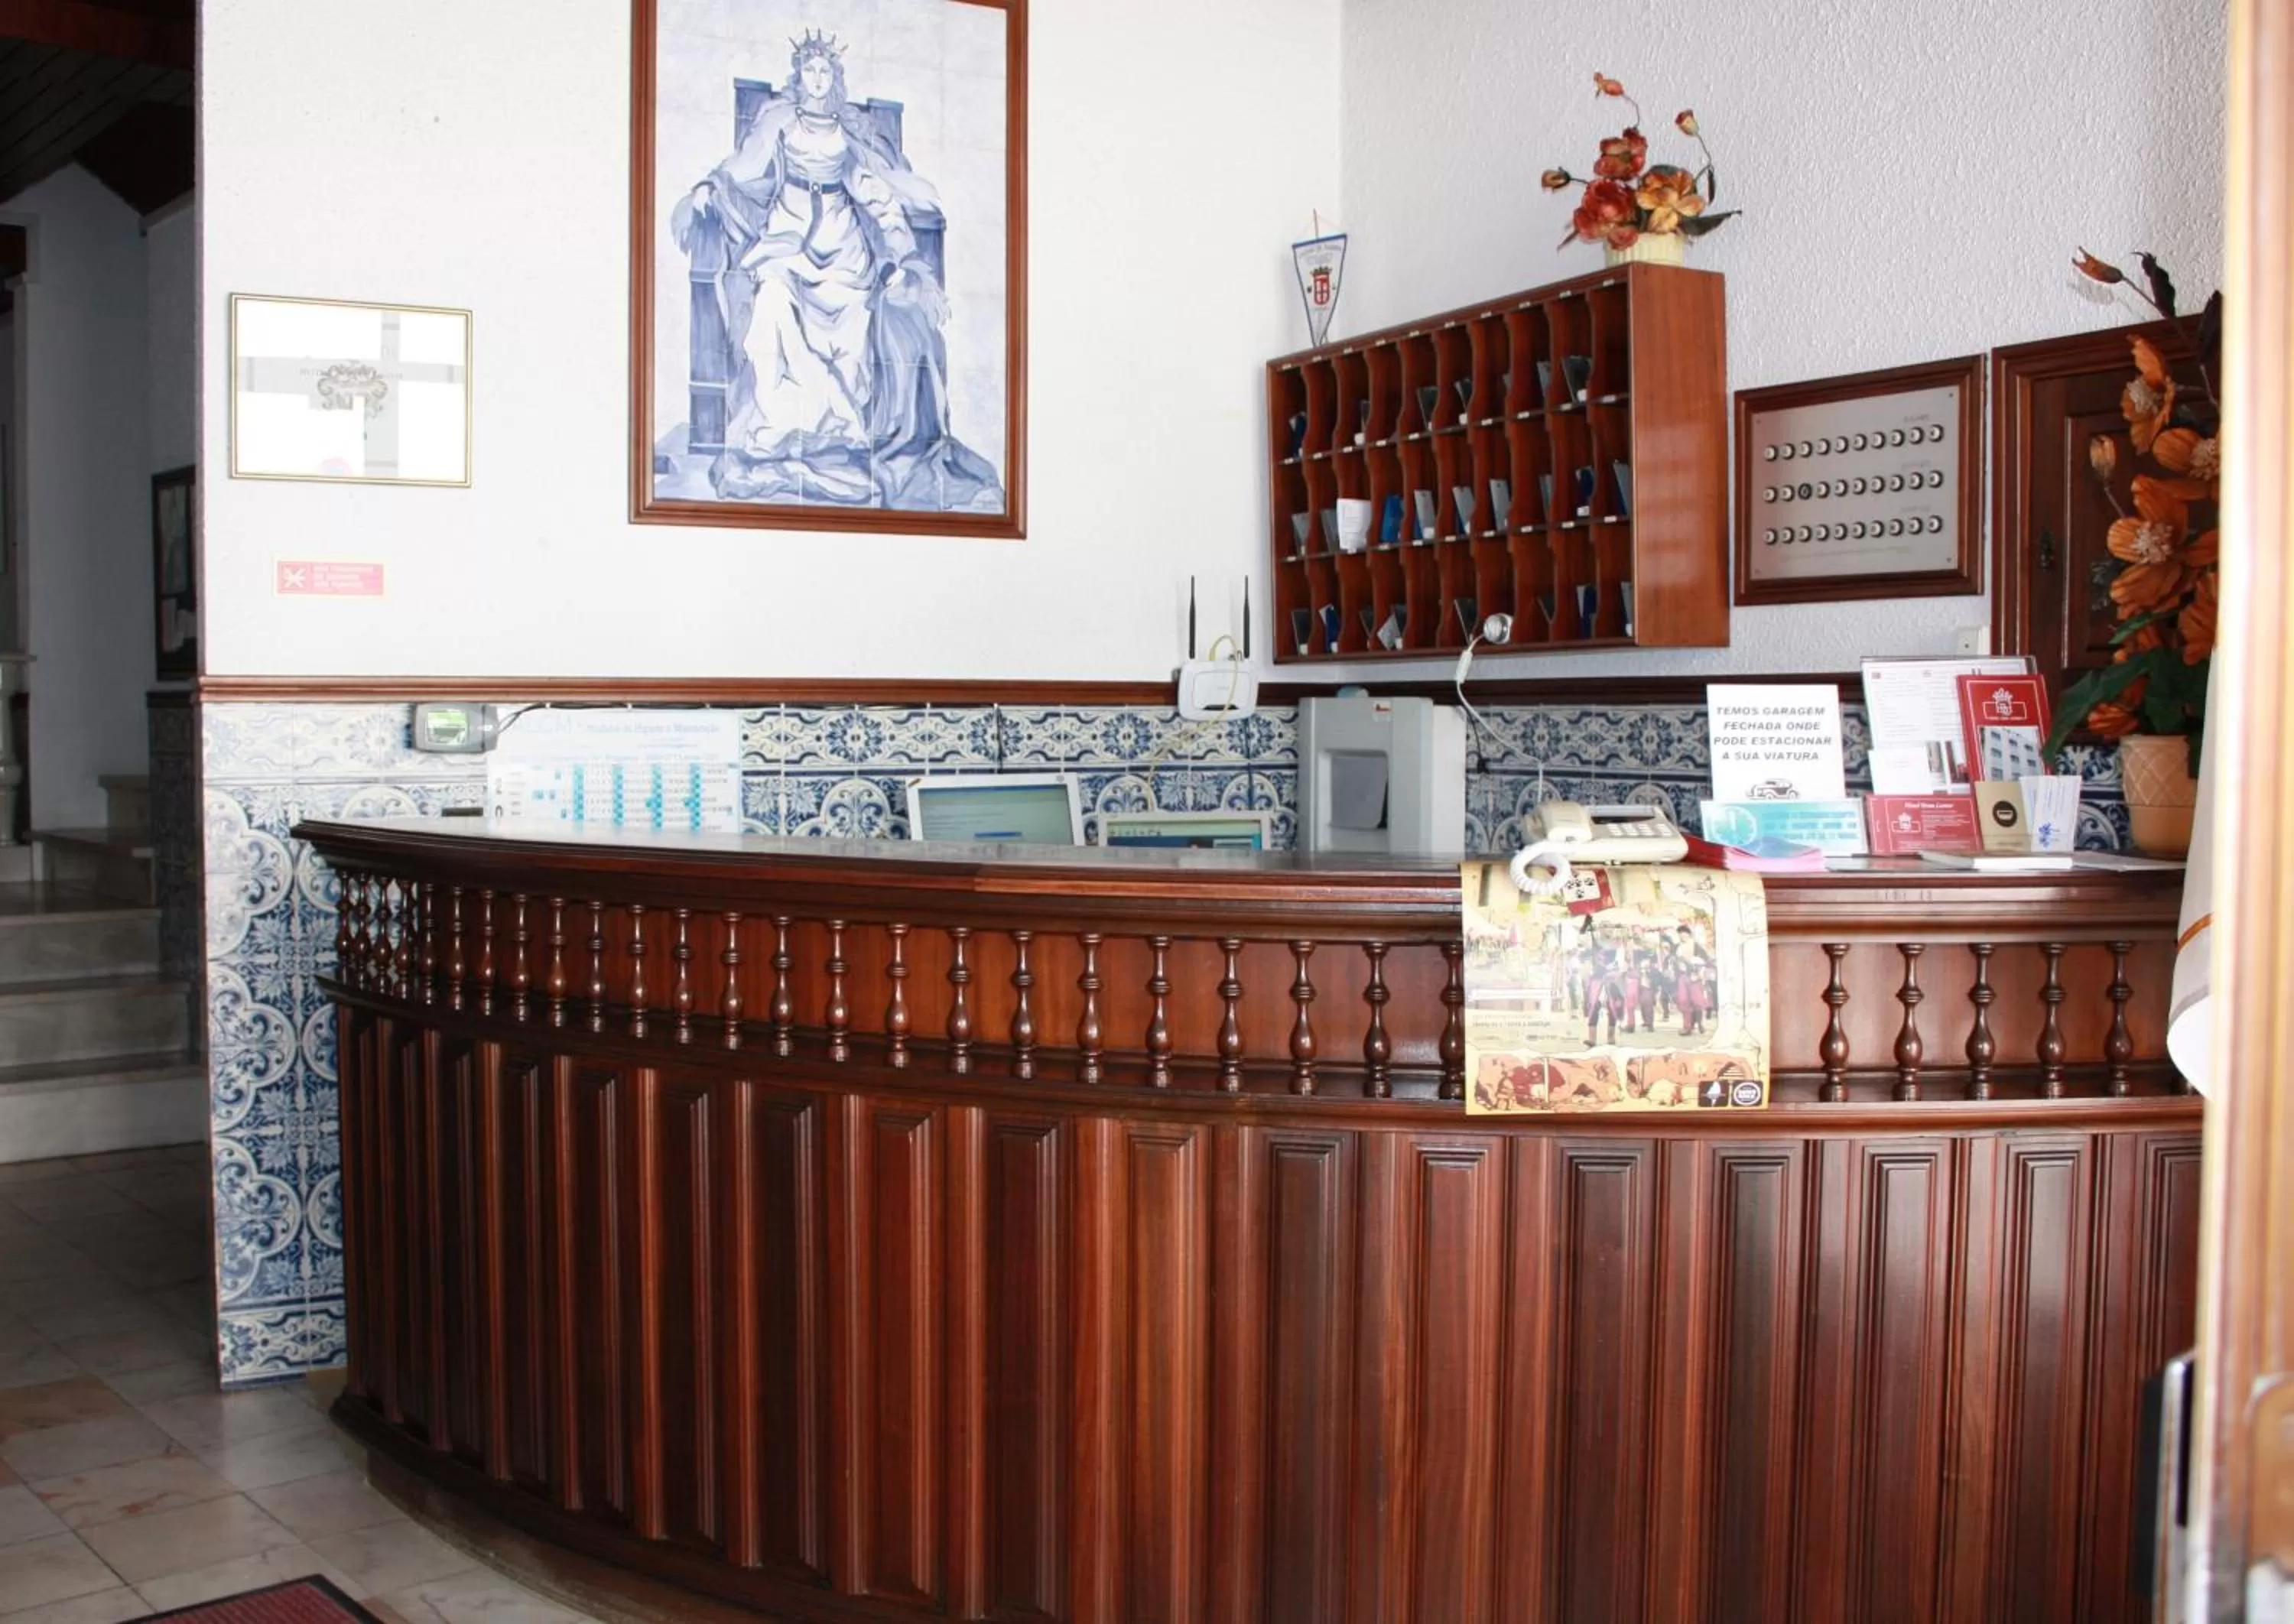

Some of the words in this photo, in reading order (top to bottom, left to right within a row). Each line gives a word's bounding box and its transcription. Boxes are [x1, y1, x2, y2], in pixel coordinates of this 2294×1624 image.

[1717, 706, 1759, 716] TEMOS
[1763, 706, 1825, 716] GARAGEM
[1724, 721, 1781, 731] FECHADA
[1786, 721, 1820, 731] ONDE
[1714, 736, 1746, 745] PODE
[1751, 736, 1832, 745] ESTACIONAR
[1722, 752, 1730, 760] A
[1735, 752, 1759, 760] SUA
[1764, 752, 1818, 760] VIATURA
